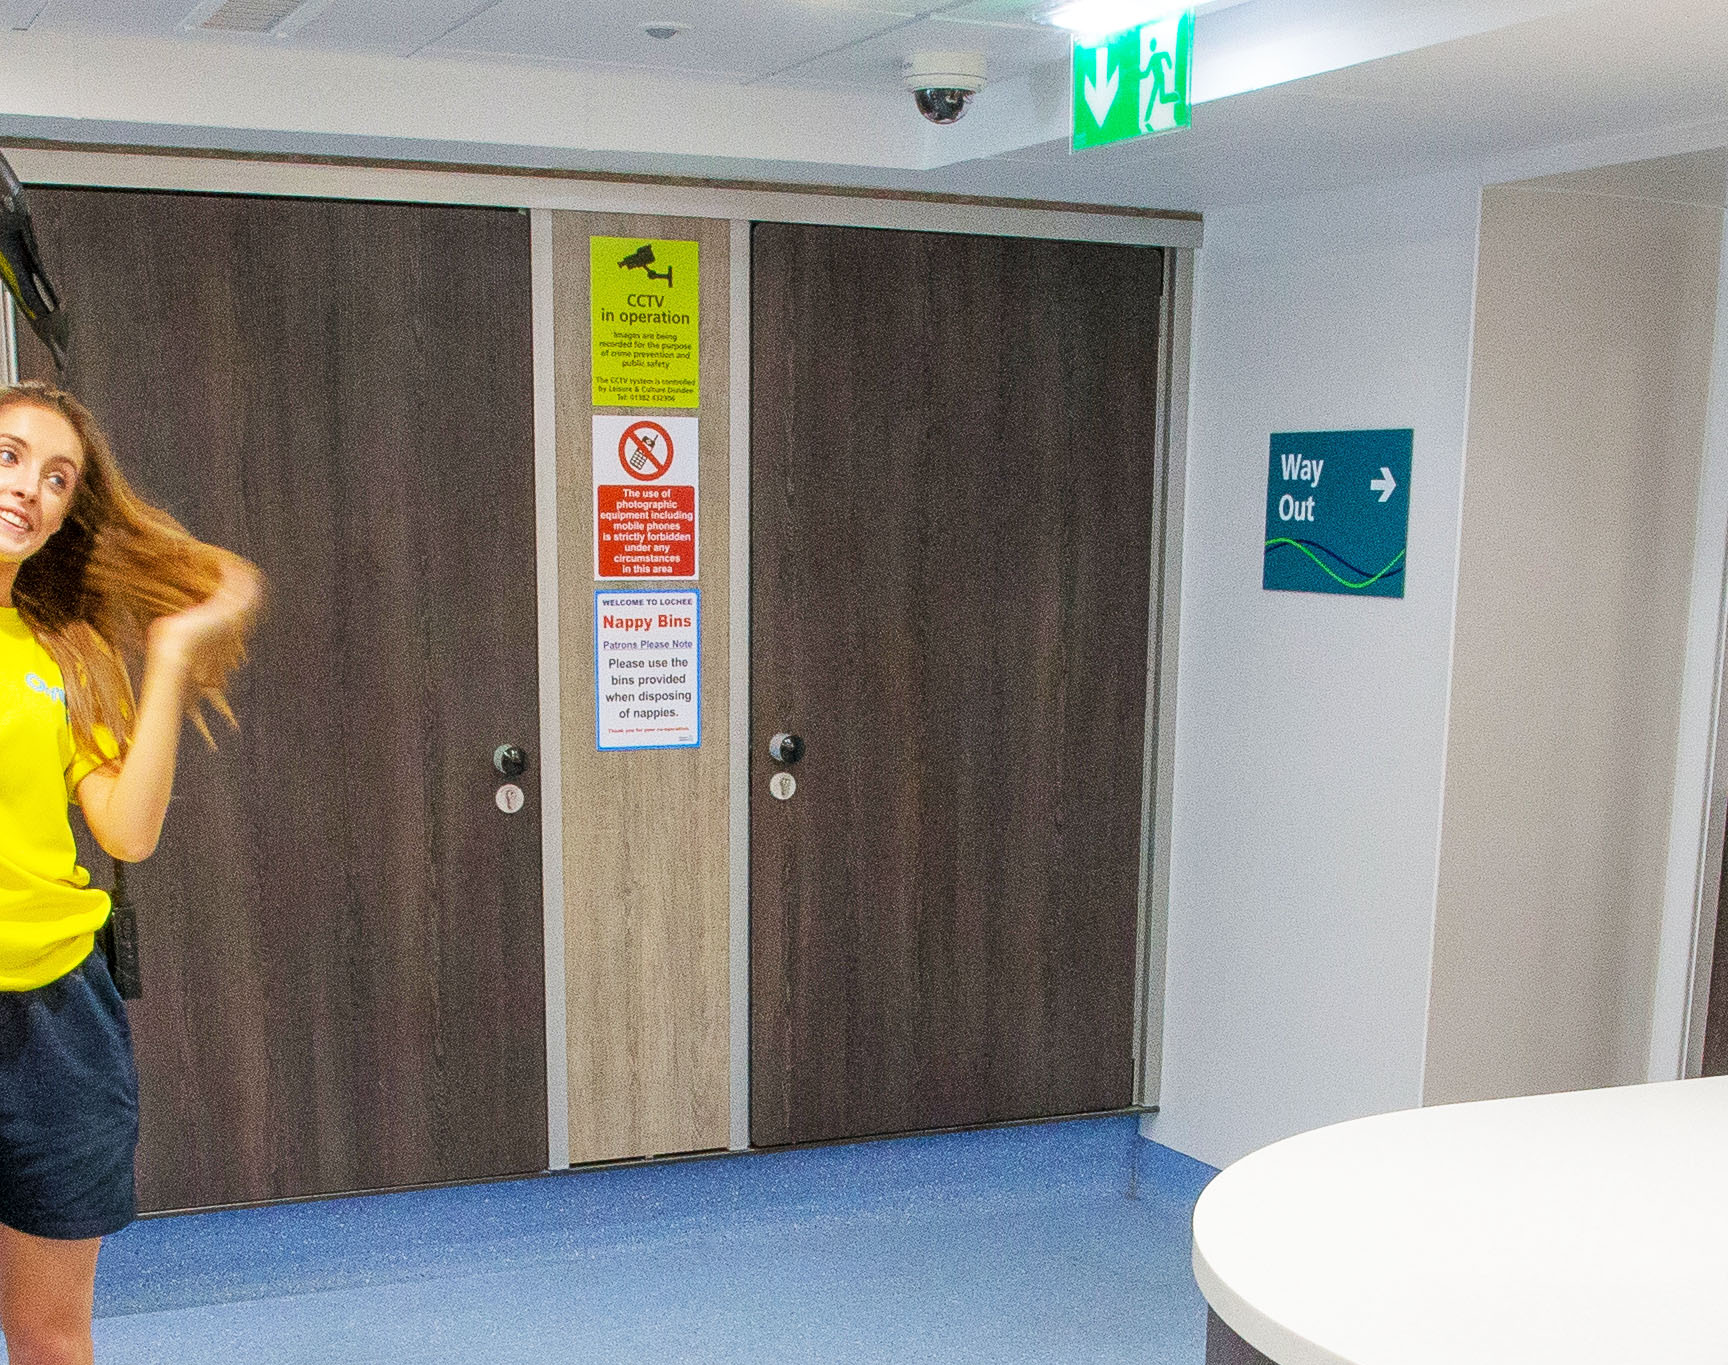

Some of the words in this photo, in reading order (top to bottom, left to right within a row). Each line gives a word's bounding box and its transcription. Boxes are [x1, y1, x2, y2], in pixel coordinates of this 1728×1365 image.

[628, 294, 664, 307] CCTV
[602, 308, 614, 321] in
[620, 311, 690, 325] operation
[656, 332, 677, 342] being
[647, 360, 670, 368] safety
[1281, 454, 1324, 488] Way
[623, 489, 640, 498] The
[643, 490, 659, 498] use
[661, 489, 671, 498] of
[616, 500, 677, 511] photographic
[1279, 494, 1315, 521] Out
[600, 511, 649, 521] equipment
[651, 511, 693, 521] including
[614, 521, 644, 530] mobile
[647, 521, 680, 531] phones
[602, 533, 611, 541] is
[614, 533, 645, 543] strictly
[647, 533, 691, 541] forbidden
[654, 545, 670, 553] any
[614, 555, 680, 563] circumstances
[622, 565, 631, 573] in
[634, 565, 650, 573] this
[603, 615, 652, 632] Nappy
[658, 614, 691, 628] Bins
[604, 641, 637, 649] Patrons
[641, 640, 670, 649] Please
[673, 640, 693, 649] Note
[609, 658, 645, 669] Please
[648, 660, 668, 668] use
[672, 657, 688, 667] the
[612, 676, 635, 685] bins
[638, 674, 686, 686] provided
[606, 692, 635, 702] when
[639, 691, 692, 703] disposing
[619, 709, 630, 718] of
[633, 709, 679, 720] nappies.
